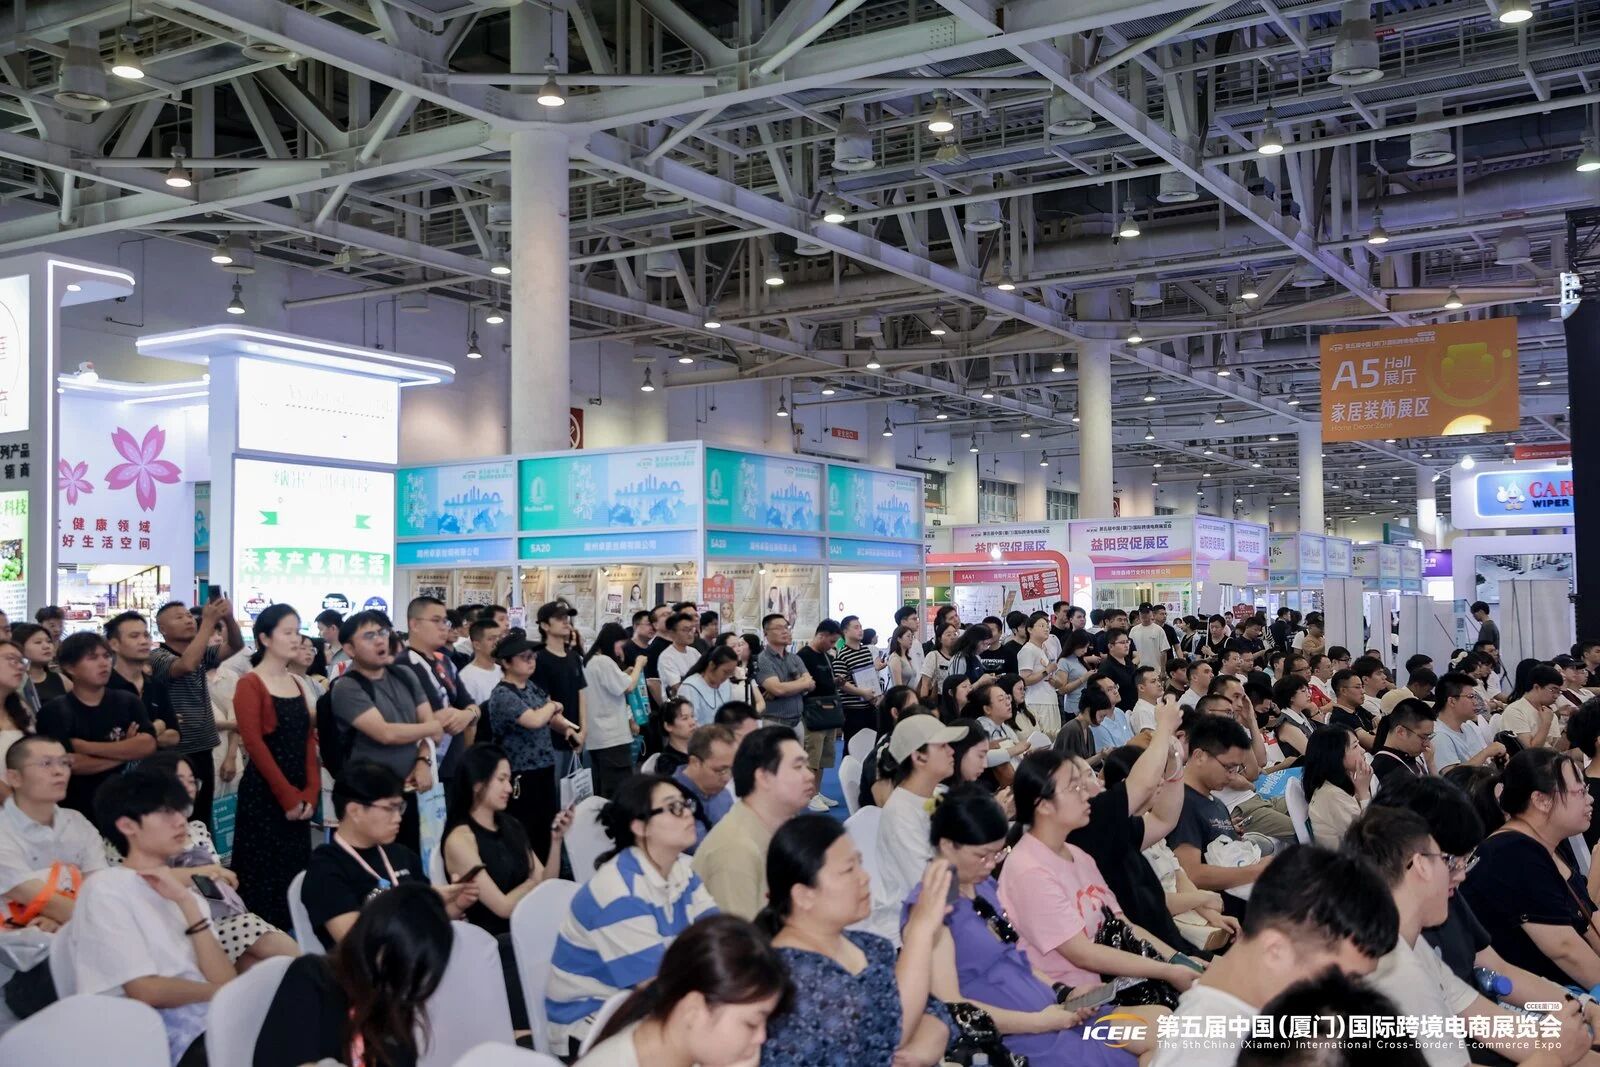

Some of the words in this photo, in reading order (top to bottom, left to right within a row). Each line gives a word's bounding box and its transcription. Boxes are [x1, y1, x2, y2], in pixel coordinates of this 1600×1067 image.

[1385, 355, 1411, 369] Hall
[1331, 358, 1380, 391] A5
[1384, 369, 1417, 386] 展厅
[1331, 397, 1431, 422] 家居装饰展区
[1533, 499, 1570, 508] WIPER
[59, 517, 151, 534] 健康领域
[62, 535, 151, 551] 好生活空间
[1091, 535, 1169, 552] 益阳贸促展区
